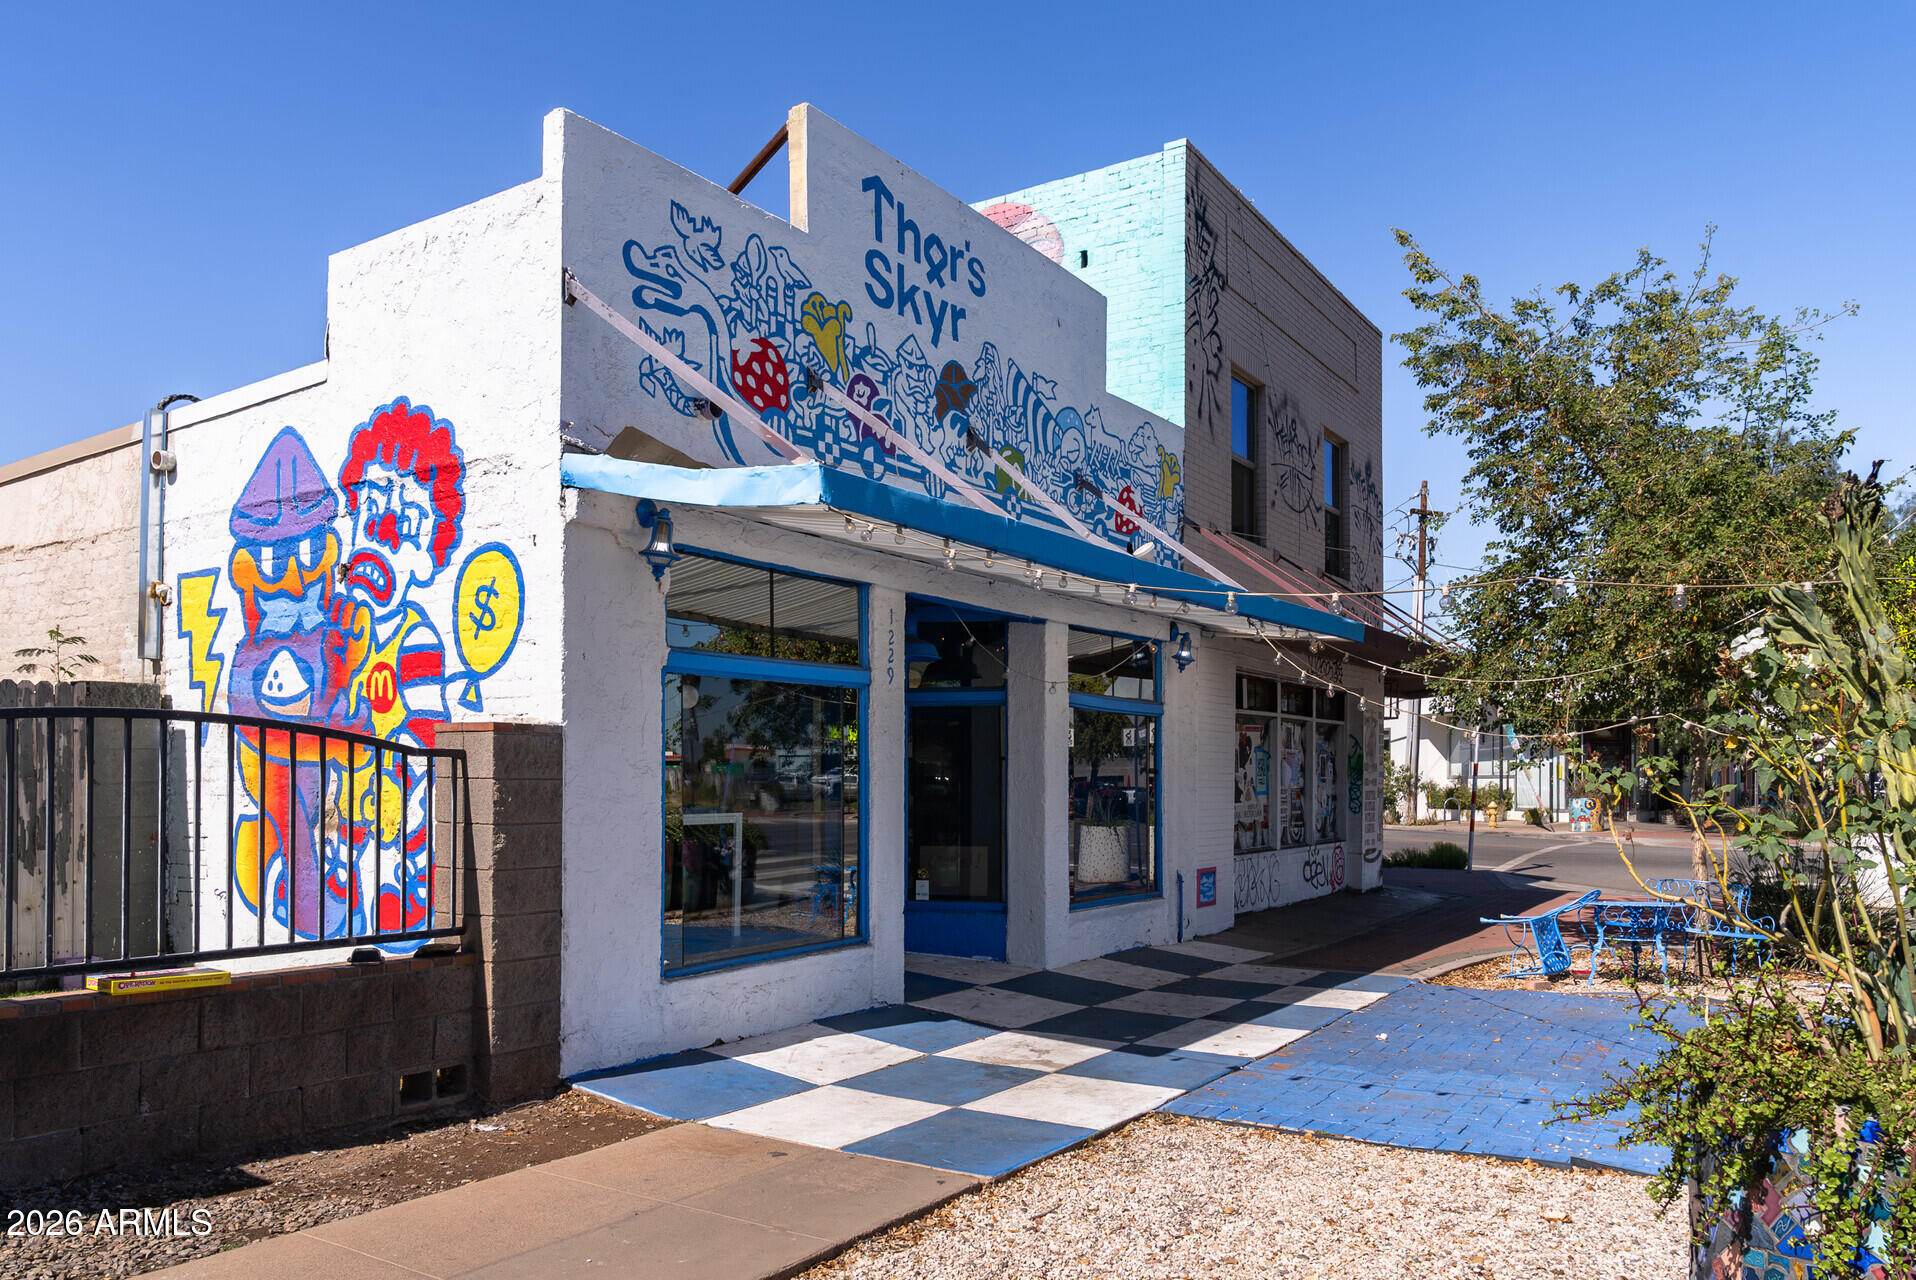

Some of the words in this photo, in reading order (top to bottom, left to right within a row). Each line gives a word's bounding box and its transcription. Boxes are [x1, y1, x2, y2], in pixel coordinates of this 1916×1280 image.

[862, 175, 986, 298] Thor's
[864, 249, 967, 349] Skyr
[886, 607, 896, 686] 1229
